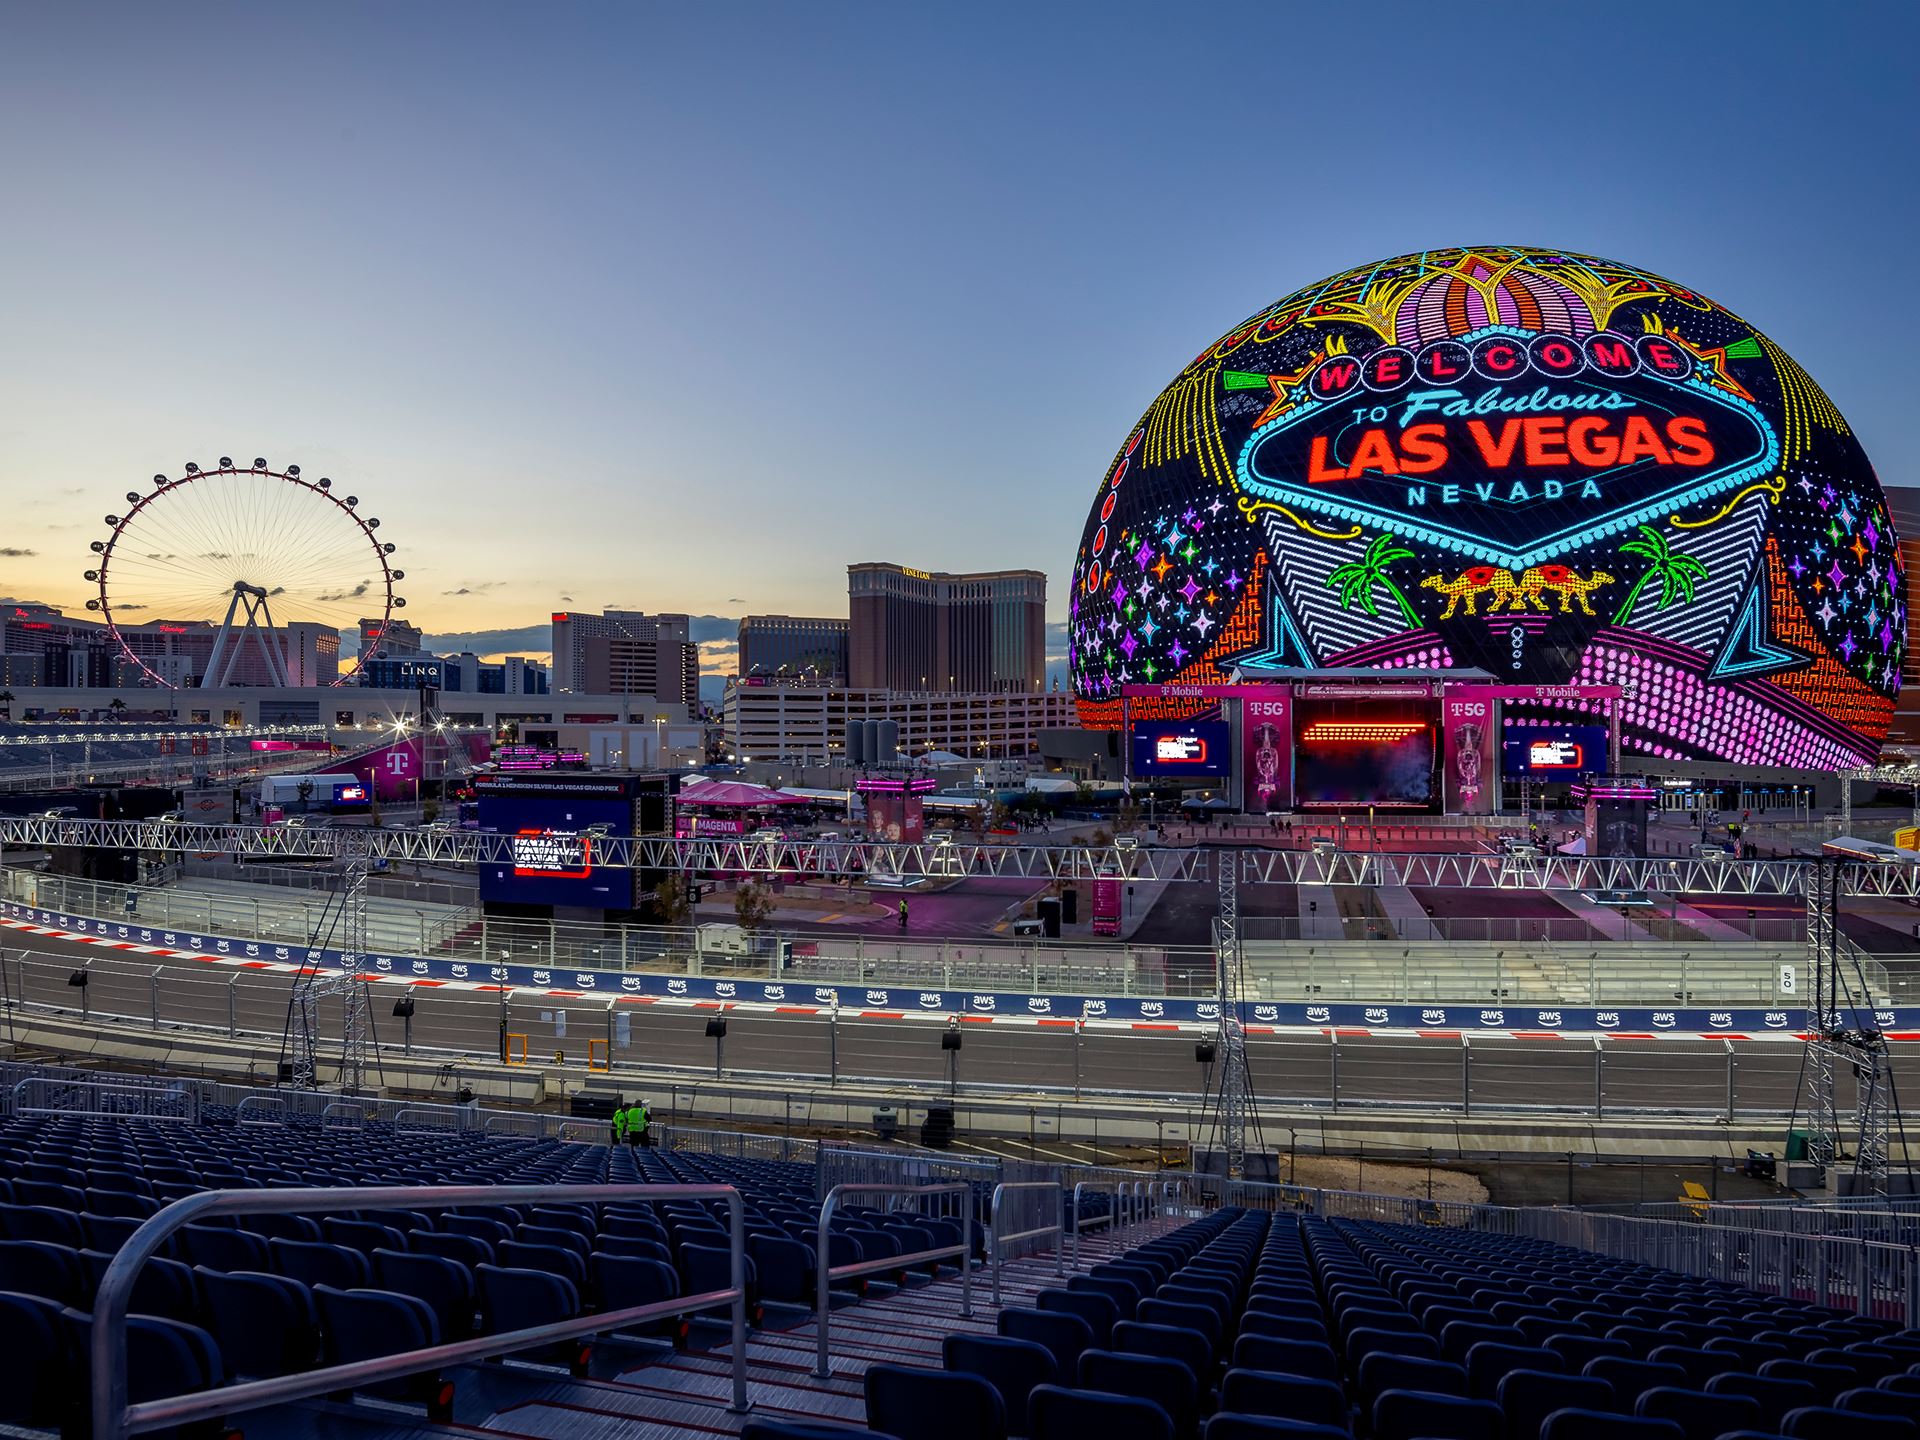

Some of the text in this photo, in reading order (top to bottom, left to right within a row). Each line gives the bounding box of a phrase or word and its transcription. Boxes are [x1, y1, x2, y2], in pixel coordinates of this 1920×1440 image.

[1319, 343, 1679, 391] WELCOME
[1353, 386, 1637, 428] TO Fabulous
[1308, 414, 1715, 483] LAS VEGAS
[1407, 479, 1602, 506] NEVADA
[902, 567, 930, 580] VENETIAN
[401, 667, 438, 676] LINQ
[1171, 686, 1203, 696] Mobile
[1546, 687, 1580, 697] Mobile
[1263, 702, 1284, 716] 5G
[1464, 703, 1485, 717] 5G
[698, 820, 737, 832] MAGENTA
